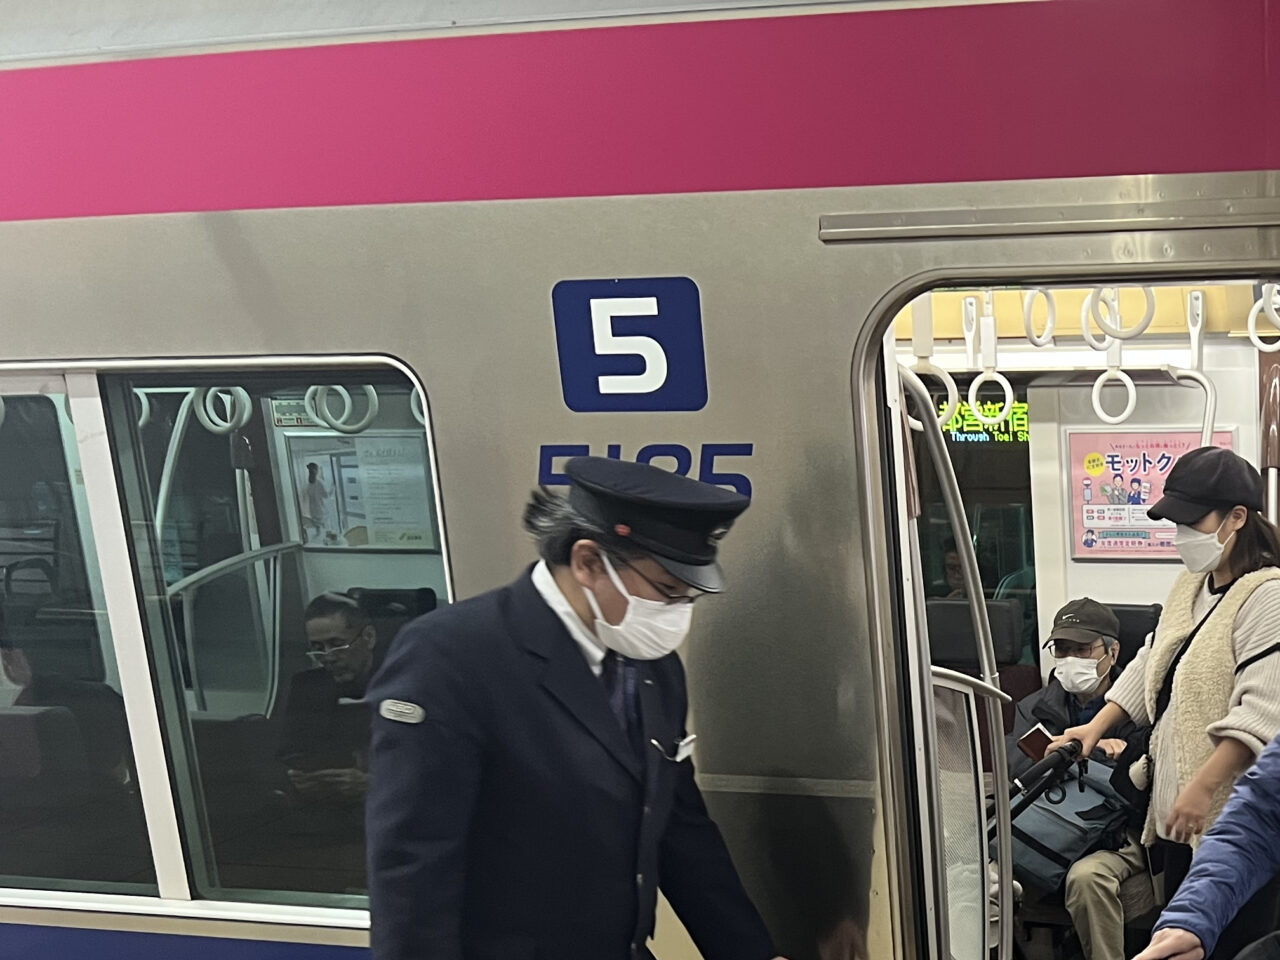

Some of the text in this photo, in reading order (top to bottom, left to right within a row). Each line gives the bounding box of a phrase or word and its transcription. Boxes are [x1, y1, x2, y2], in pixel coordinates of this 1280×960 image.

[589, 296, 668, 394] 5
[950, 431, 990, 442] Through
[993, 431, 1013, 442] Toei
[538, 443, 754, 500] 55
[1105, 451, 1172, 473] モットク
